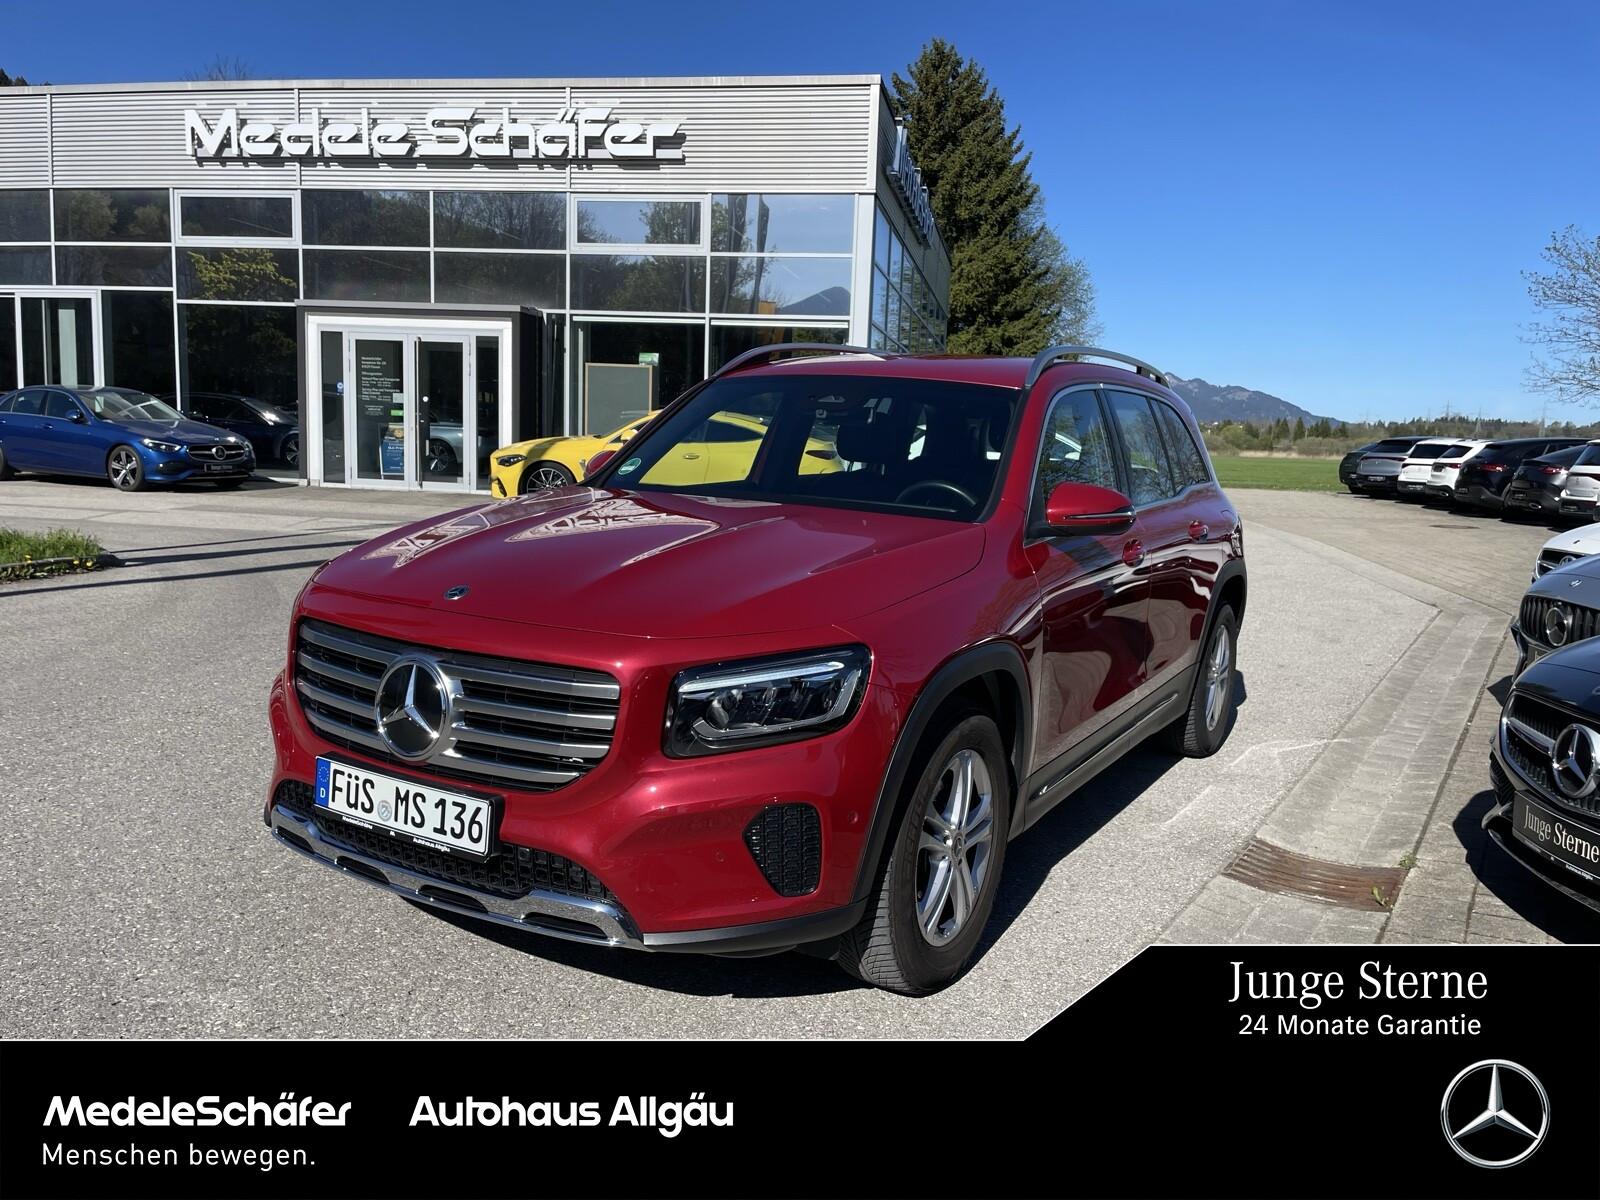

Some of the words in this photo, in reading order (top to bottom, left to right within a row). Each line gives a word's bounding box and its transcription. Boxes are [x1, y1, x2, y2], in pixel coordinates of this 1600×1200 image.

[319, 787, 326, 799] D
[394, 786, 427, 829] MS
[432, 798, 483, 844] 136
[1523, 804, 1551, 842] Junge
[1553, 822, 1600, 863] Sterne
